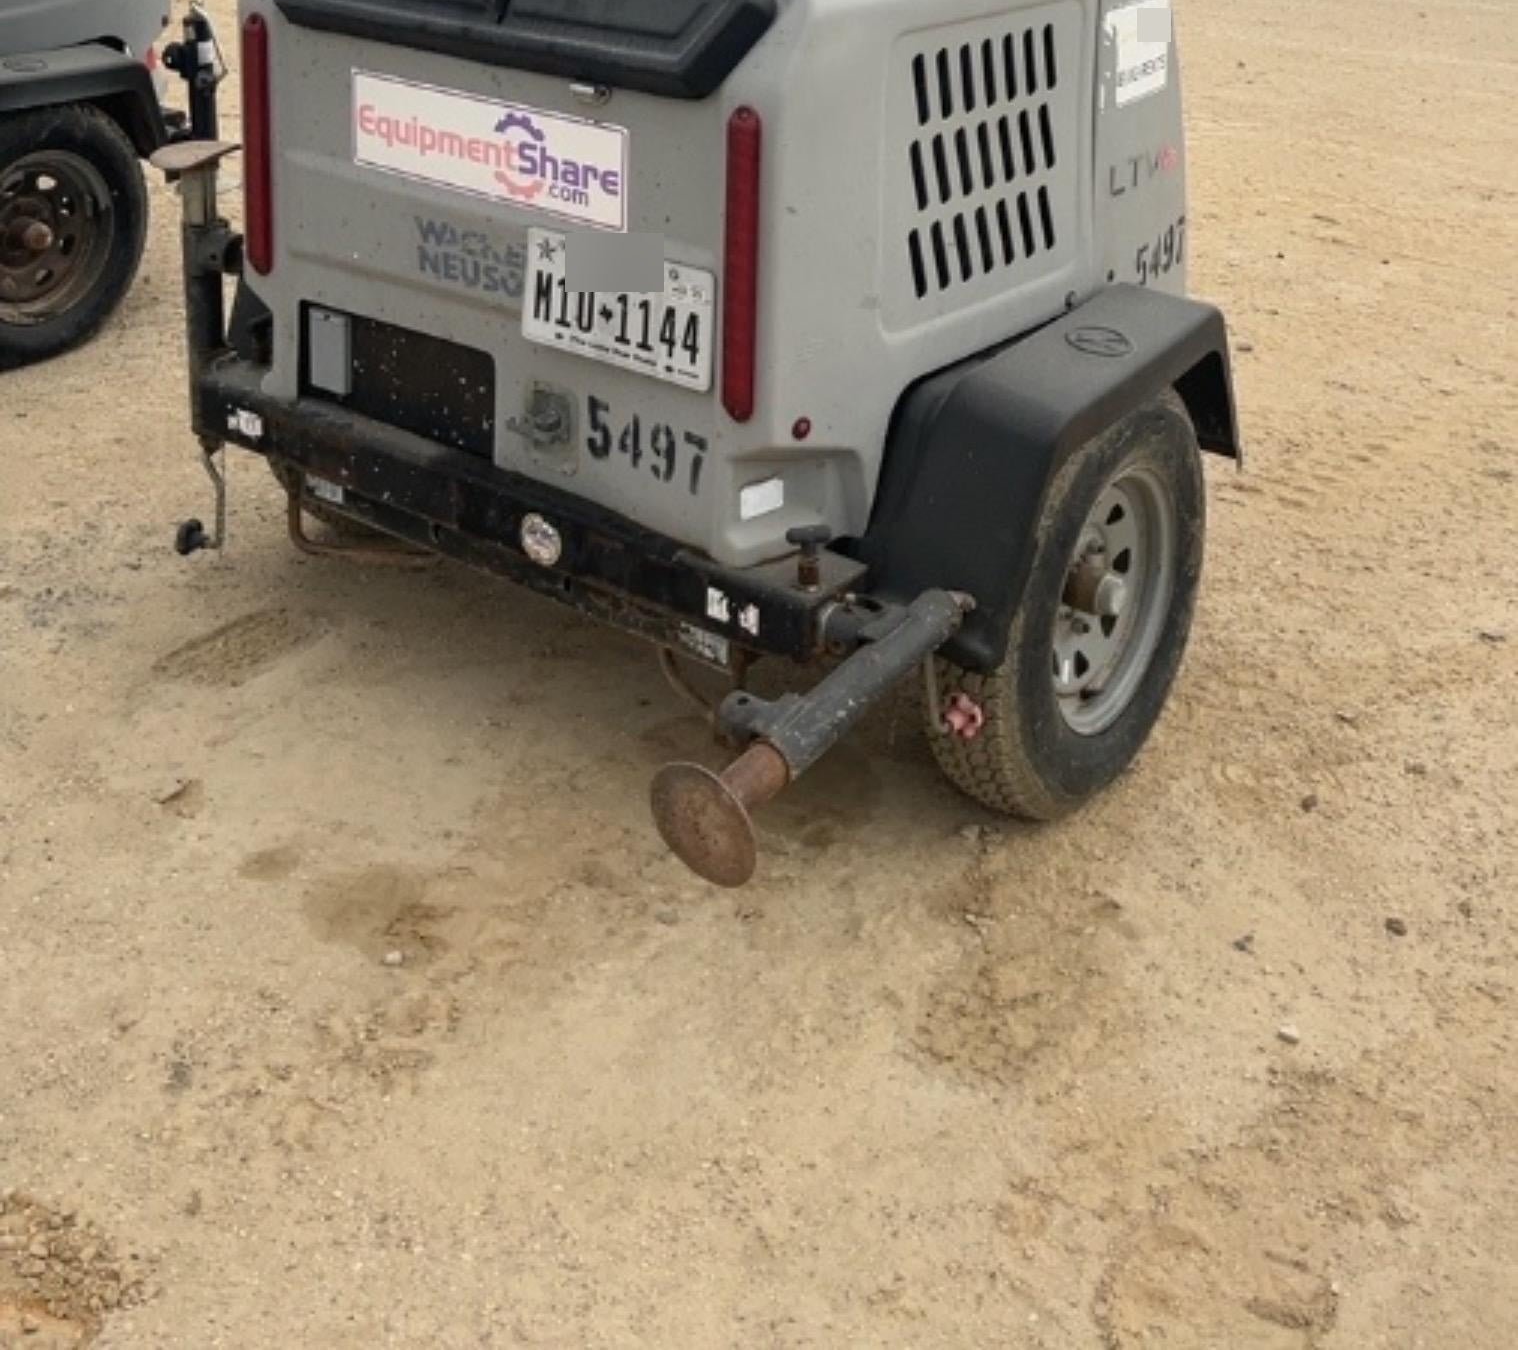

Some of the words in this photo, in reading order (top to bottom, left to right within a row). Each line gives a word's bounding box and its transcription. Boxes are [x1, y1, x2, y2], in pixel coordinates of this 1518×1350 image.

[358, 104, 619, 196] EquipmentShare
[1136, 214, 1187, 286] 5497
[587, 394, 708, 496] 5497
